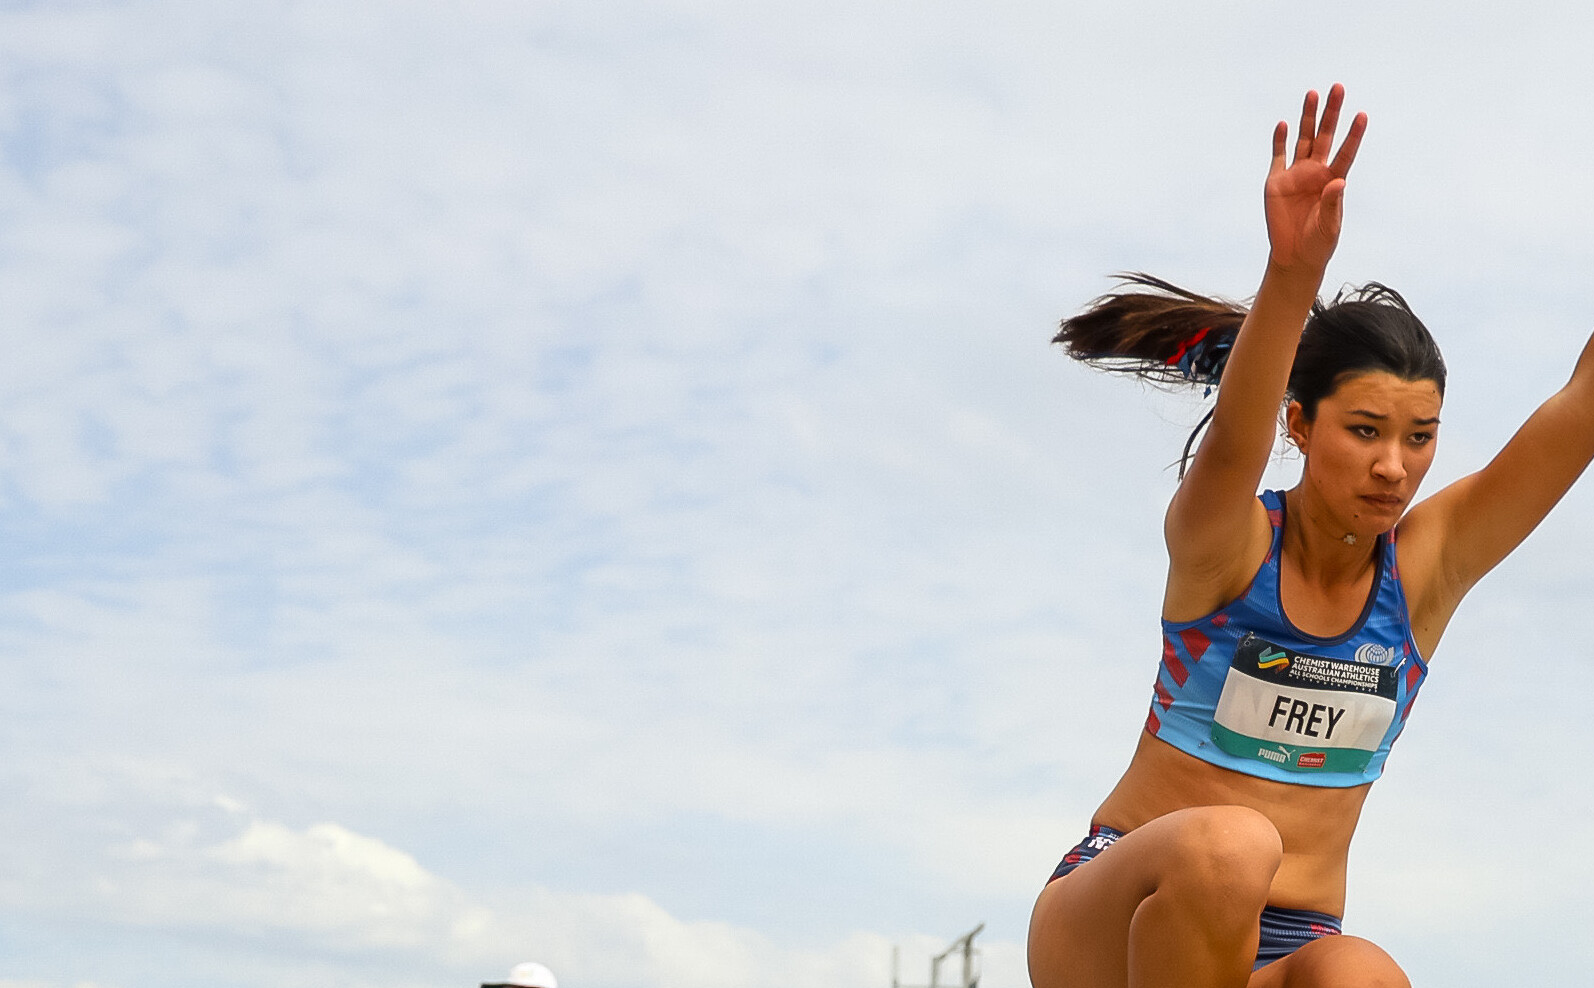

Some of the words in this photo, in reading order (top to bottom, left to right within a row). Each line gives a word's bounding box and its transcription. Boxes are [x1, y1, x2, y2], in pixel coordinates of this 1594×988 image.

[1291, 663, 1340, 677] AUSTRALIAN
[1340, 671, 1380, 683] ATHLETICS
[1294, 656, 1330, 668] CHEMIST
[1330, 661, 1380, 676] WAREHOUSE
[1302, 671, 1330, 682] SCHOOLS
[1330, 676, 1378, 690] CHAMPIONSHIPS
[1268, 695, 1346, 740] FREY
[1258, 748, 1287, 764] PUMA
